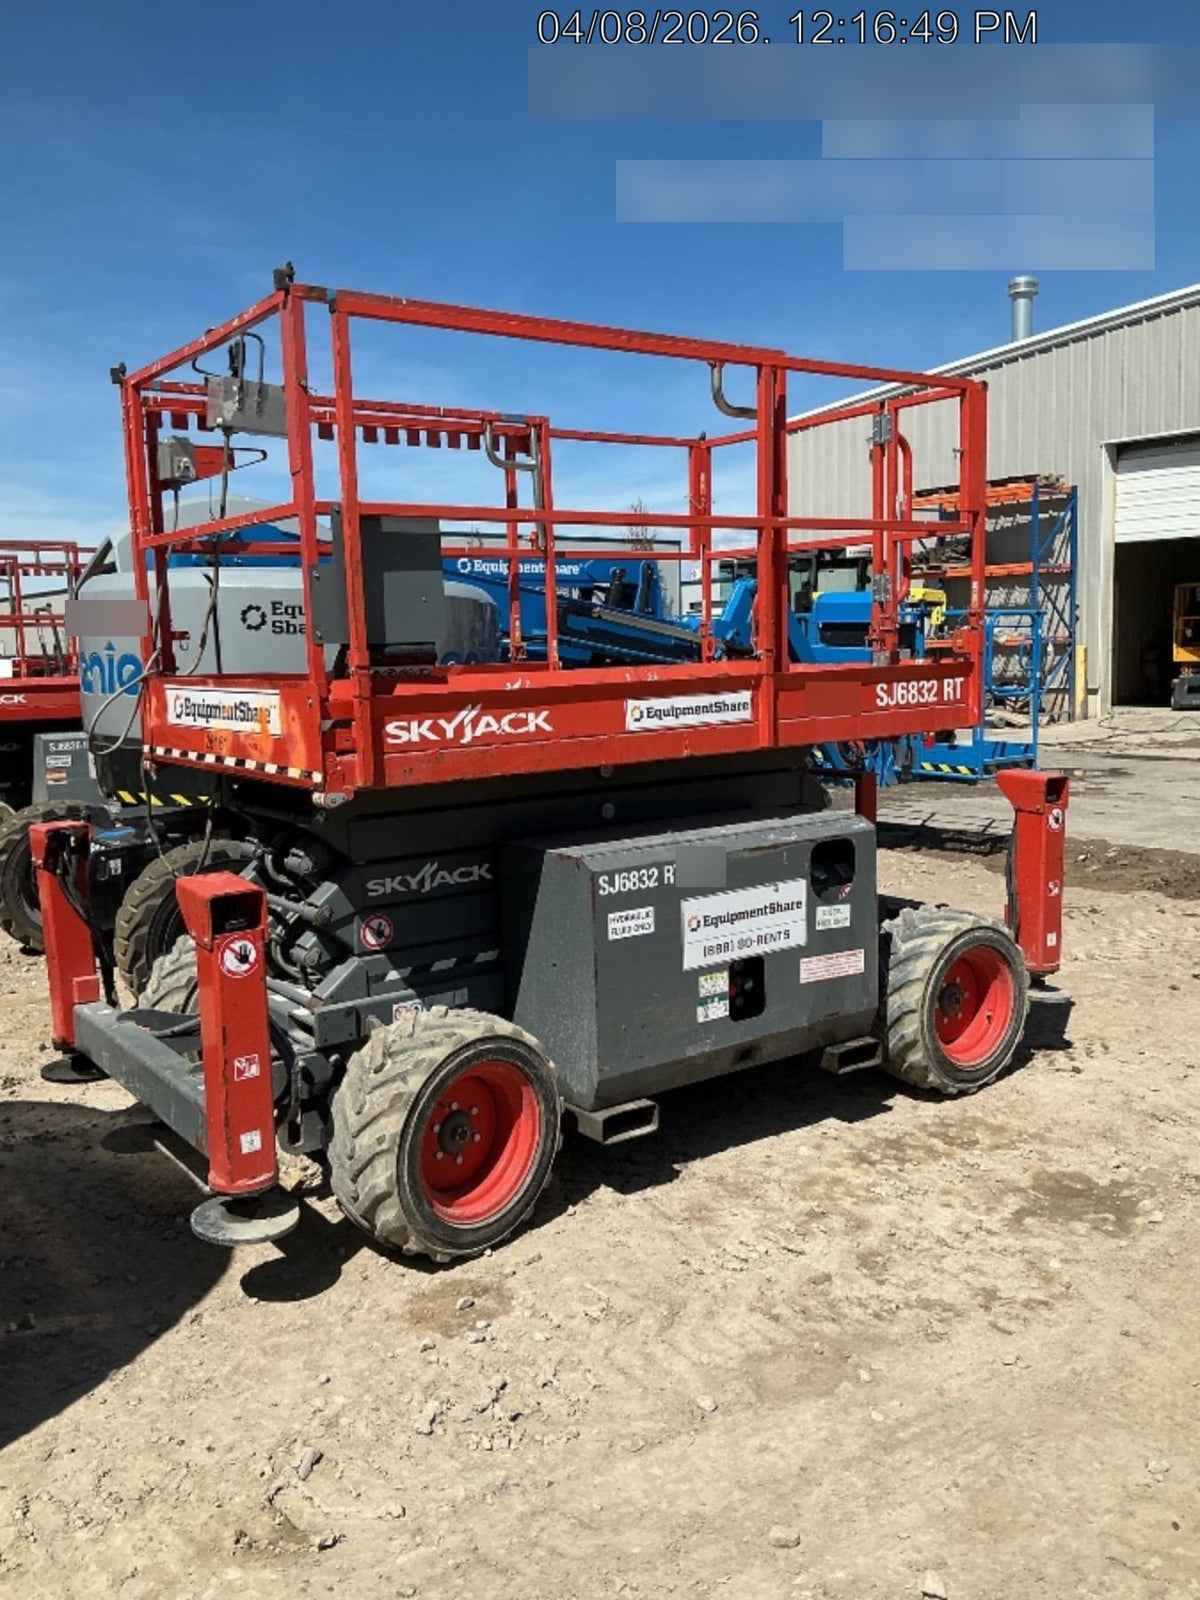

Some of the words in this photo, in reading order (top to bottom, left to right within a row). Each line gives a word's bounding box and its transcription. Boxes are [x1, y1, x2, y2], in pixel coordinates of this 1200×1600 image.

[876, 679, 938, 707] SJ6832
[943, 677, 965, 701] RT
[184, 697, 272, 724] EquipmentShare
[385, 702, 554, 744] SKYJACK
[645, 701, 750, 720] EquipmentShare
[366, 861, 493, 896] SKYJACK
[598, 867, 659, 895] SJ6832
[663, 863, 677, 884] R
[703, 899, 803, 928] EquipmentShare
